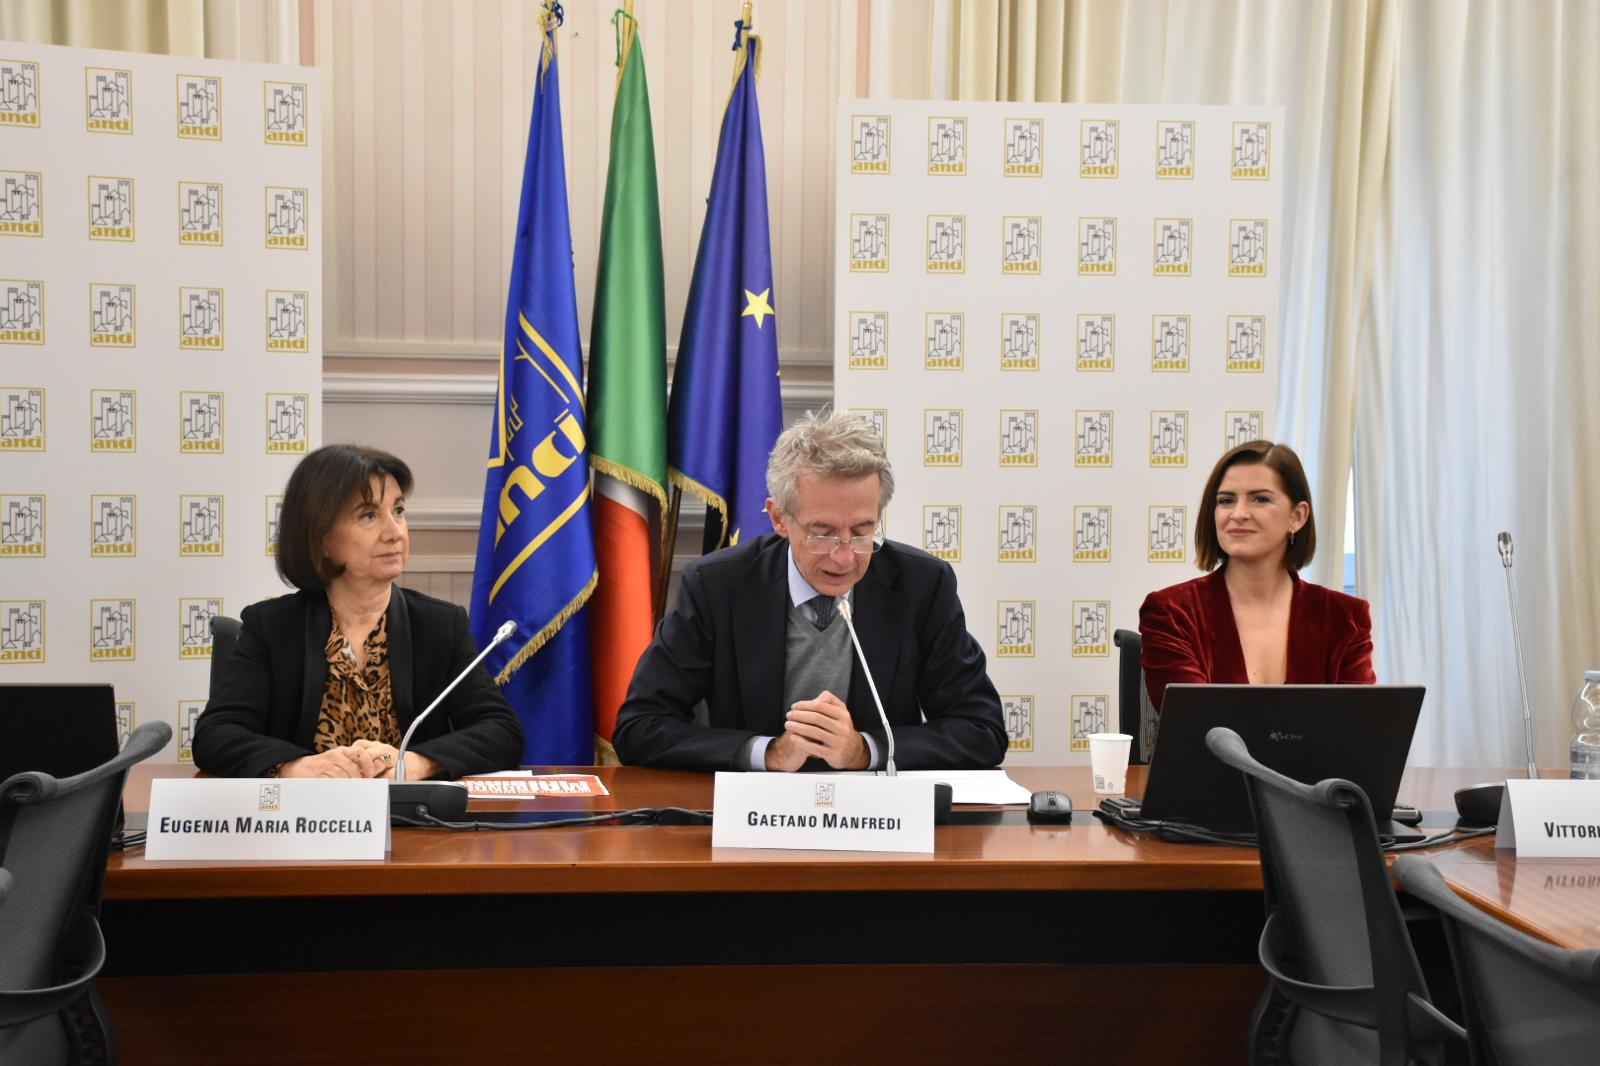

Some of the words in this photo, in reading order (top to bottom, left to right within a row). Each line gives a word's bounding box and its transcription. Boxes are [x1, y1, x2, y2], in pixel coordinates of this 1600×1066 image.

[0, 112, 37, 124] anci
[90, 117, 129, 130] anci
[180, 124, 218, 136] anci
[267, 130, 304, 142] anci
[853, 160, 887, 171] anci
[928, 161, 962, 172] anci
[1006, 162, 1039, 174] anci
[1081, 164, 1115, 175] anci
[1158, 166, 1191, 176] anci
[1233, 166, 1266, 176] anci
[0, 222, 40, 233] anci
[91, 227, 130, 238] anci
[182, 230, 220, 242] anci
[268, 235, 304, 246] anci
[852, 259, 886, 270] anci
[928, 260, 962, 270] anci
[1004, 261, 1038, 271] anci
[1080, 262, 1113, 272] anci
[1155, 262, 1188, 273] anci
[1230, 264, 1264, 274] anci
[0, 329, 41, 341] anci
[92, 332, 132, 344] anci
[182, 335, 220, 346] anci
[268, 338, 305, 349] anci
[850, 356, 884, 366] anci
[927, 357, 960, 368] anci
[1002, 358, 1036, 368] anci
[1078, 358, 1111, 369] anci
[1154, 359, 1187, 370] anci
[1228, 360, 1261, 370] anci
[0, 436, 42, 448] anci
[93, 437, 132, 449] anci
[182, 439, 220, 450] anci
[268, 440, 305, 451] anci
[926, 453, 960, 463] anci
[1001, 454, 1034, 464] anci
[1076, 454, 1110, 464] anci
[1151, 454, 1184, 464] anci
[494, 409, 586, 551] nci
[0, 542, 42, 554] anci
[93, 542, 132, 554] anci
[182, 542, 220, 553] anci
[1000, 548, 1034, 560] anci
[1074, 548, 1108, 560] anci
[1150, 548, 1183, 560] anci
[0, 647, 42, 660] anci
[92, 646, 132, 658] anci
[182, 646, 213, 656] anc
[999, 643, 1032, 654] anci
[1073, 643, 1106, 654] anci
[1008, 737, 1031, 749] nci
[160, 816, 230, 833] EUGENIA
[235, 816, 290, 833] MARIA
[295, 816, 373, 833] ROCCELLA
[748, 811, 818, 828] GAETANO
[822, 813, 901, 830] MANFREDI
